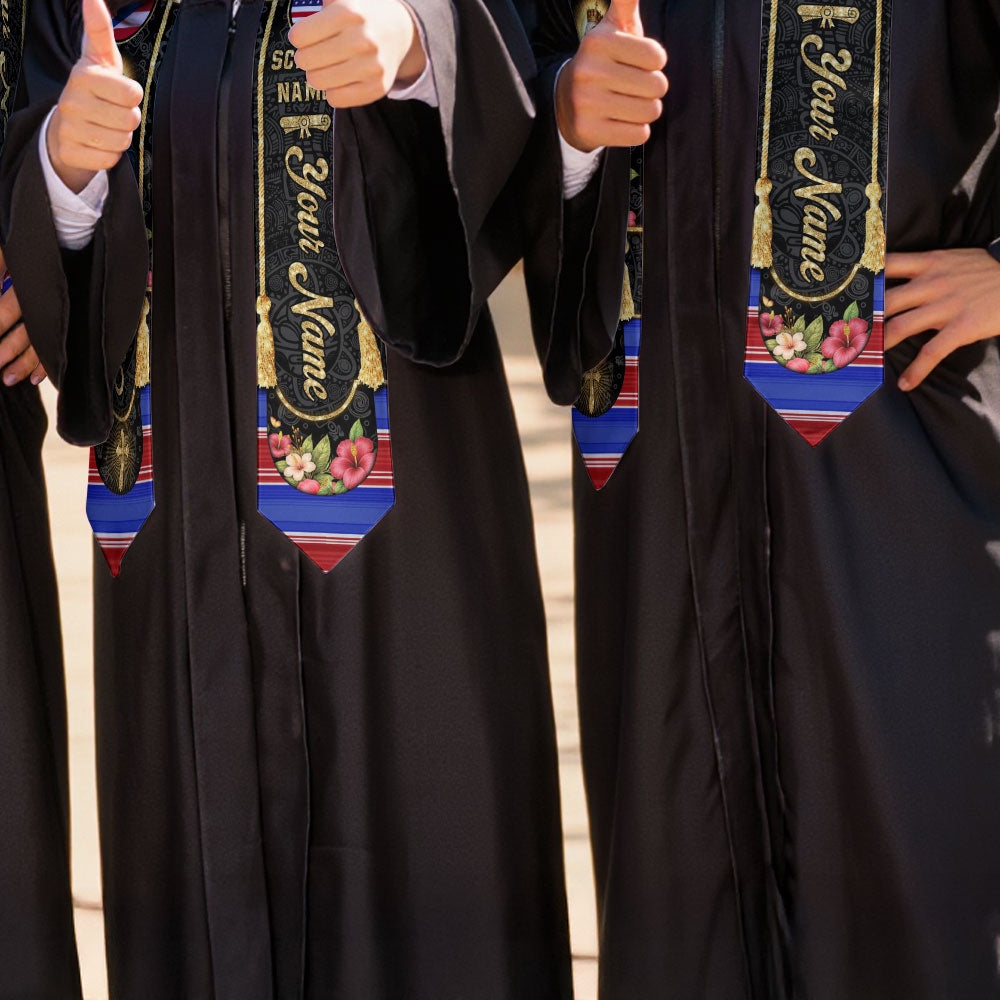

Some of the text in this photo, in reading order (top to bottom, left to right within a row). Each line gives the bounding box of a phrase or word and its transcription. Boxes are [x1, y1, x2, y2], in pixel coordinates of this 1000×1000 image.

[285, 145, 336, 402] Your Name
[793, 34, 852, 284] Your Name
